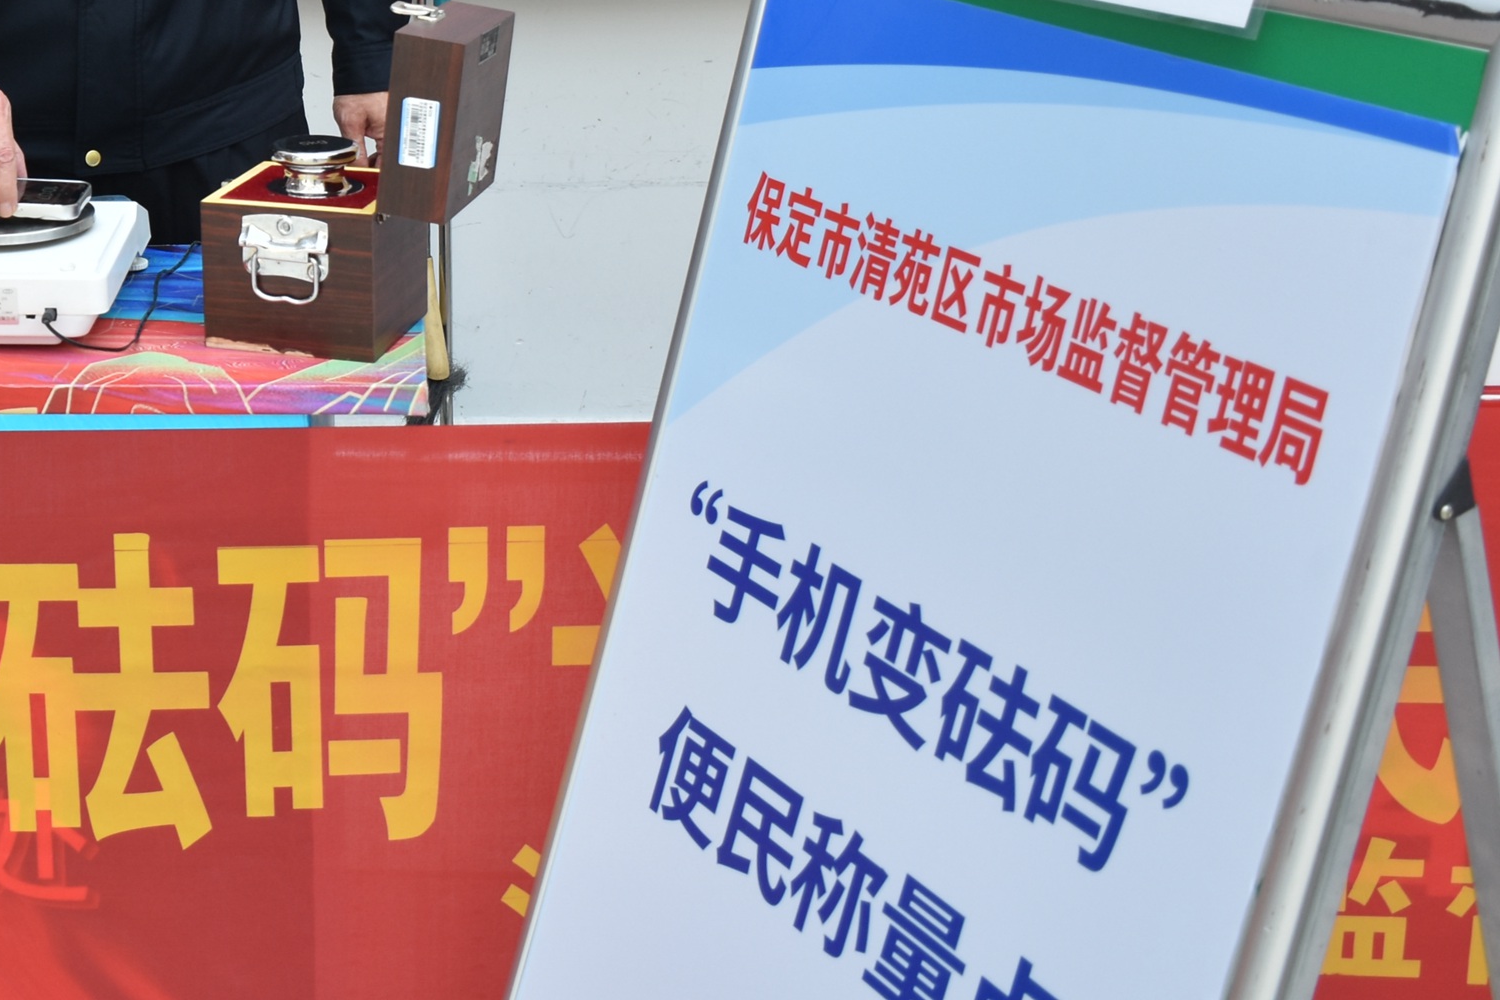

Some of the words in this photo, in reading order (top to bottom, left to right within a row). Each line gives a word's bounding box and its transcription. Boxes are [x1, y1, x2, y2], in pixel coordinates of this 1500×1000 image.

[743, 171, 1329, 486] 保定市清苑区市场监督管理局
[690, 480, 1189, 873] “手机变砝码”
